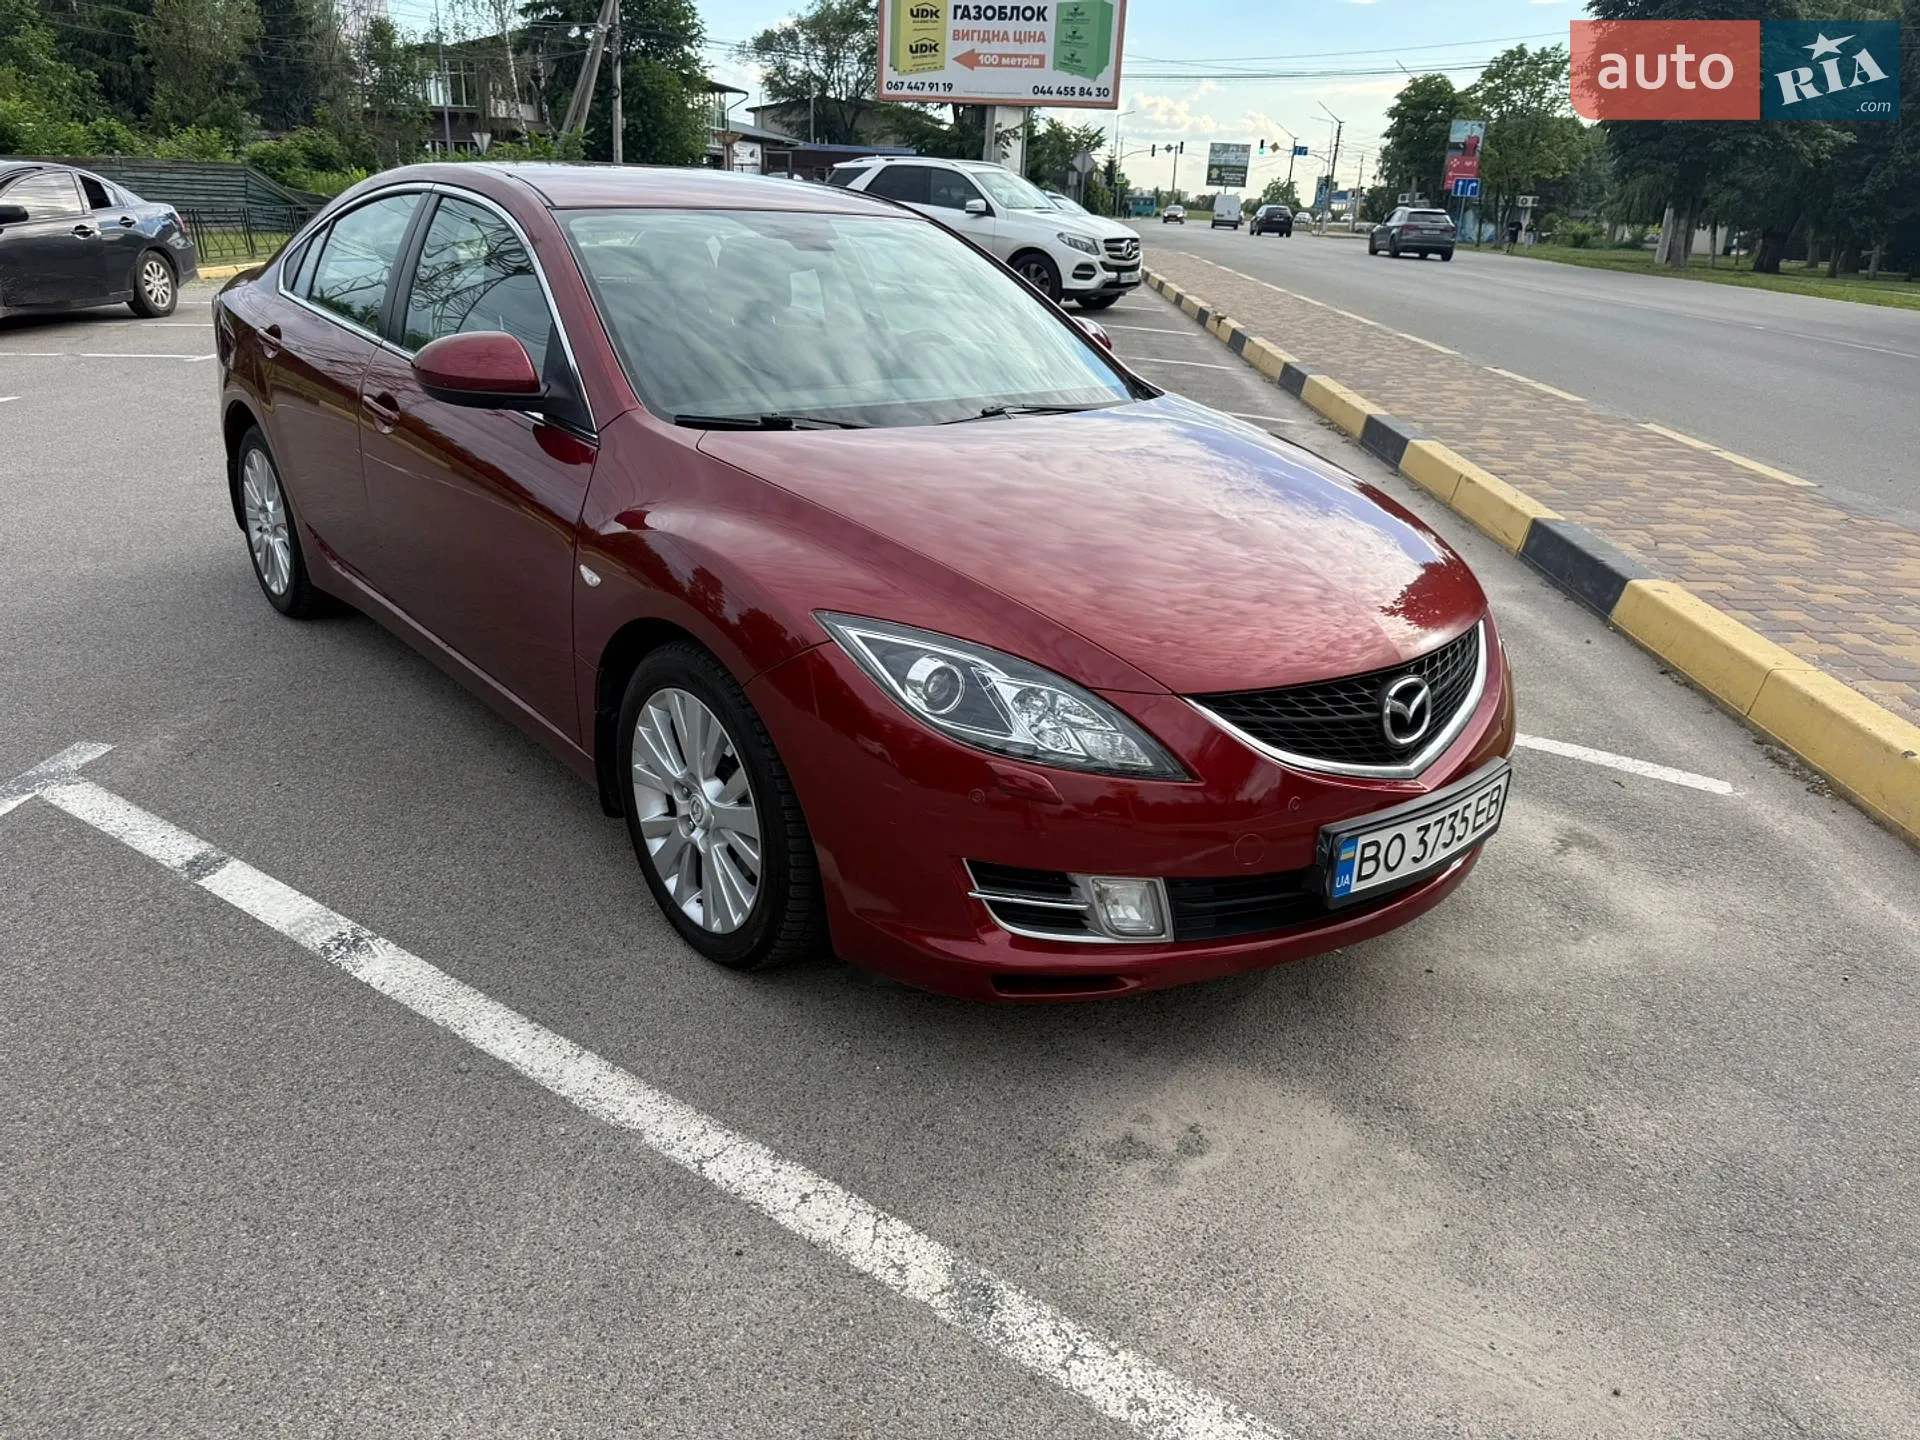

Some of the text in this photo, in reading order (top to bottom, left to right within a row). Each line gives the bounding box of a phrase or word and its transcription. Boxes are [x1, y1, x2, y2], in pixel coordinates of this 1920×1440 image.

[909, 7, 940, 19] UDK
[953, 4, 1048, 22] ГАЗОБЛОК
[952, 29, 1010, 44] ВИГІДНА
[1013, 30, 1047, 45] ЦІНА
[909, 42, 939, 54] UDK
[978, 54, 1040, 68] 100 метрів
[886, 81, 954, 92] 067 447 91 19
[1032, 85, 1053, 96] 044
[1056, 86, 1076, 97] 455
[1078, 86, 1093, 97] 84
[1095, 87, 1110, 98] 30
[1356, 784, 1502, 883] BO 3735 EB
[1335, 876, 1350, 889] UA
